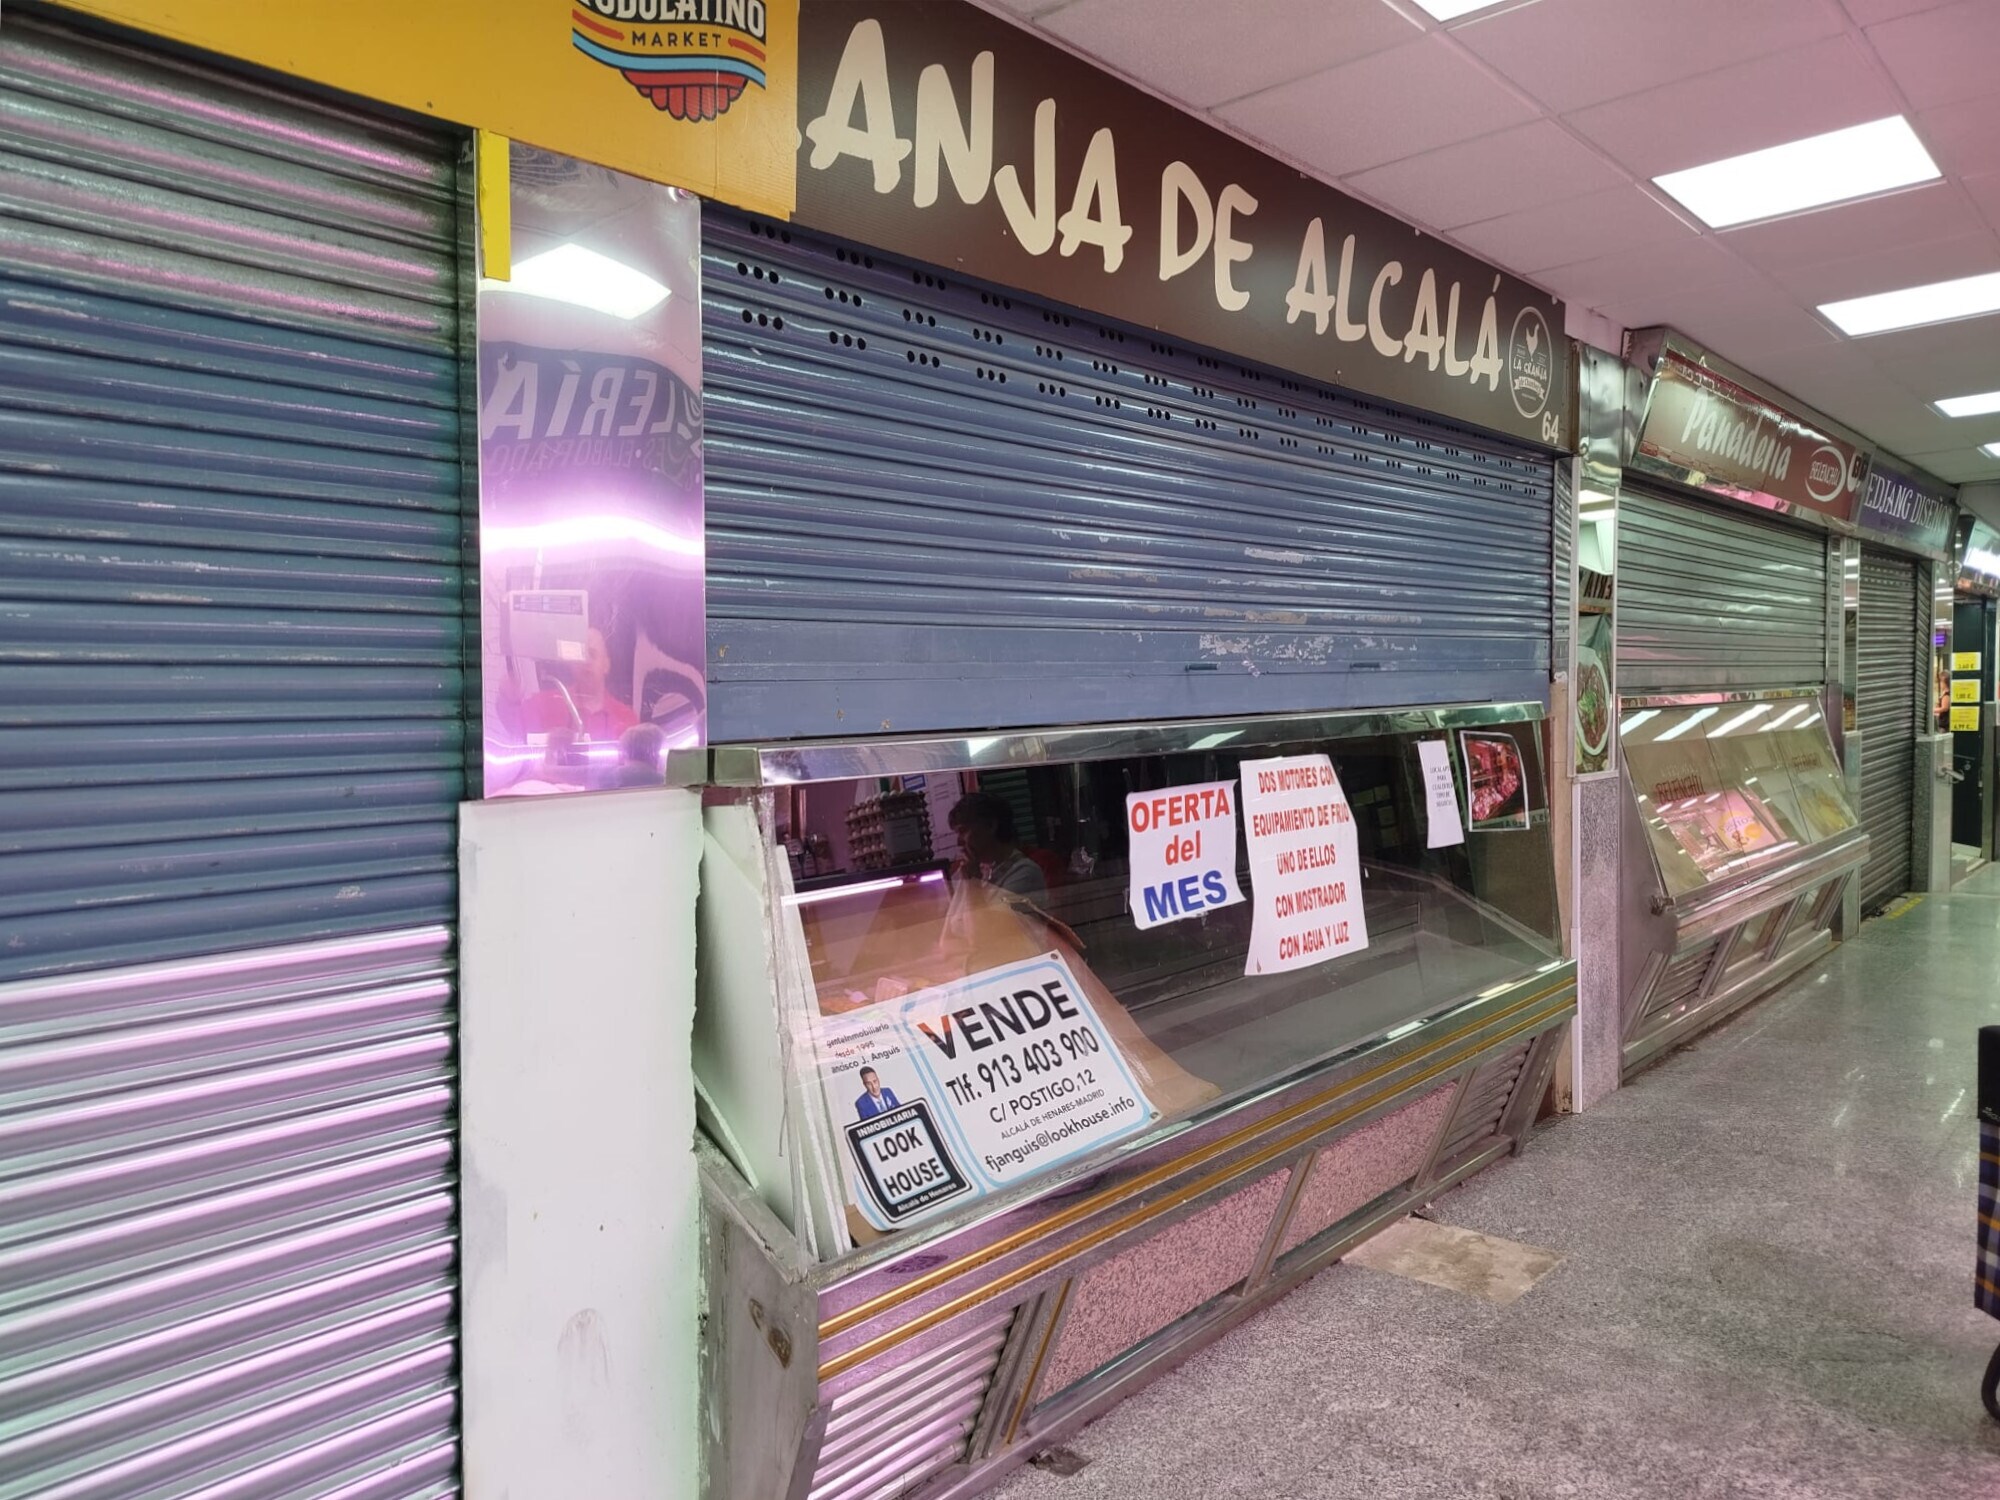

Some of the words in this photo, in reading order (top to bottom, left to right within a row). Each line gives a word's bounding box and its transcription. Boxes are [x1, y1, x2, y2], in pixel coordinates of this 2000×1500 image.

[631, 31, 722, 48] MARKET
[797, 18, 1133, 274] ANJA
[1160, 161, 1258, 312] DE
[1286, 217, 1503, 392] ALCALÁ
[1542, 410, 1560, 444] 64
[1258, 771, 1277, 794] DOS
[1277, 767, 1317, 791] MOTORES
[1131, 788, 1230, 833] OFERTA
[1252, 806, 1315, 838] EQUIPAMIENTO
[1318, 804, 1329, 826] DE
[1165, 830, 1201, 866] del
[1276, 851, 1296, 875] UNO
[1297, 849, 1309, 870] DE
[1310, 844, 1336, 869] ELLOS
[1143, 870, 1228, 922] MES
[1275, 894, 1294, 919] CON
[1295, 881, 1347, 914] MOSTRADOR
[1279, 935, 1300, 961] CON
[1302, 929, 1325, 956] AGUA
[1325, 926, 1333, 948] Y
[1334, 921, 1350, 944] LUZ
[917, 980, 1079, 1060] VENDE
[856, 1040, 875, 1052] 1995
[861, 1055, 870, 1065] J.
[871, 1045, 901, 1061] Anguis
[945, 1072, 983, 1106] Tlf.
[977, 1052, 1022, 1094] 913
[1022, 1039, 1063, 1076] 403
[1059, 1026, 1100, 1061] 900
[857, 1108, 918, 1138] INMOBILIARIA
[989, 1101, 1008, 1123] C/
[1000, 1121, 1030, 1140] ALCALÁ
[1030, 1117, 1042, 1127] DE
[1041, 1088, 1105, 1122] HENARES-MADRID
[873, 1126, 923, 1162] LOOK
[985, 1096, 1135, 1173] fjanguis@lookhouse.info
[883, 1157, 944, 1198] HOUSE
[920, 1193, 930, 1202] de
